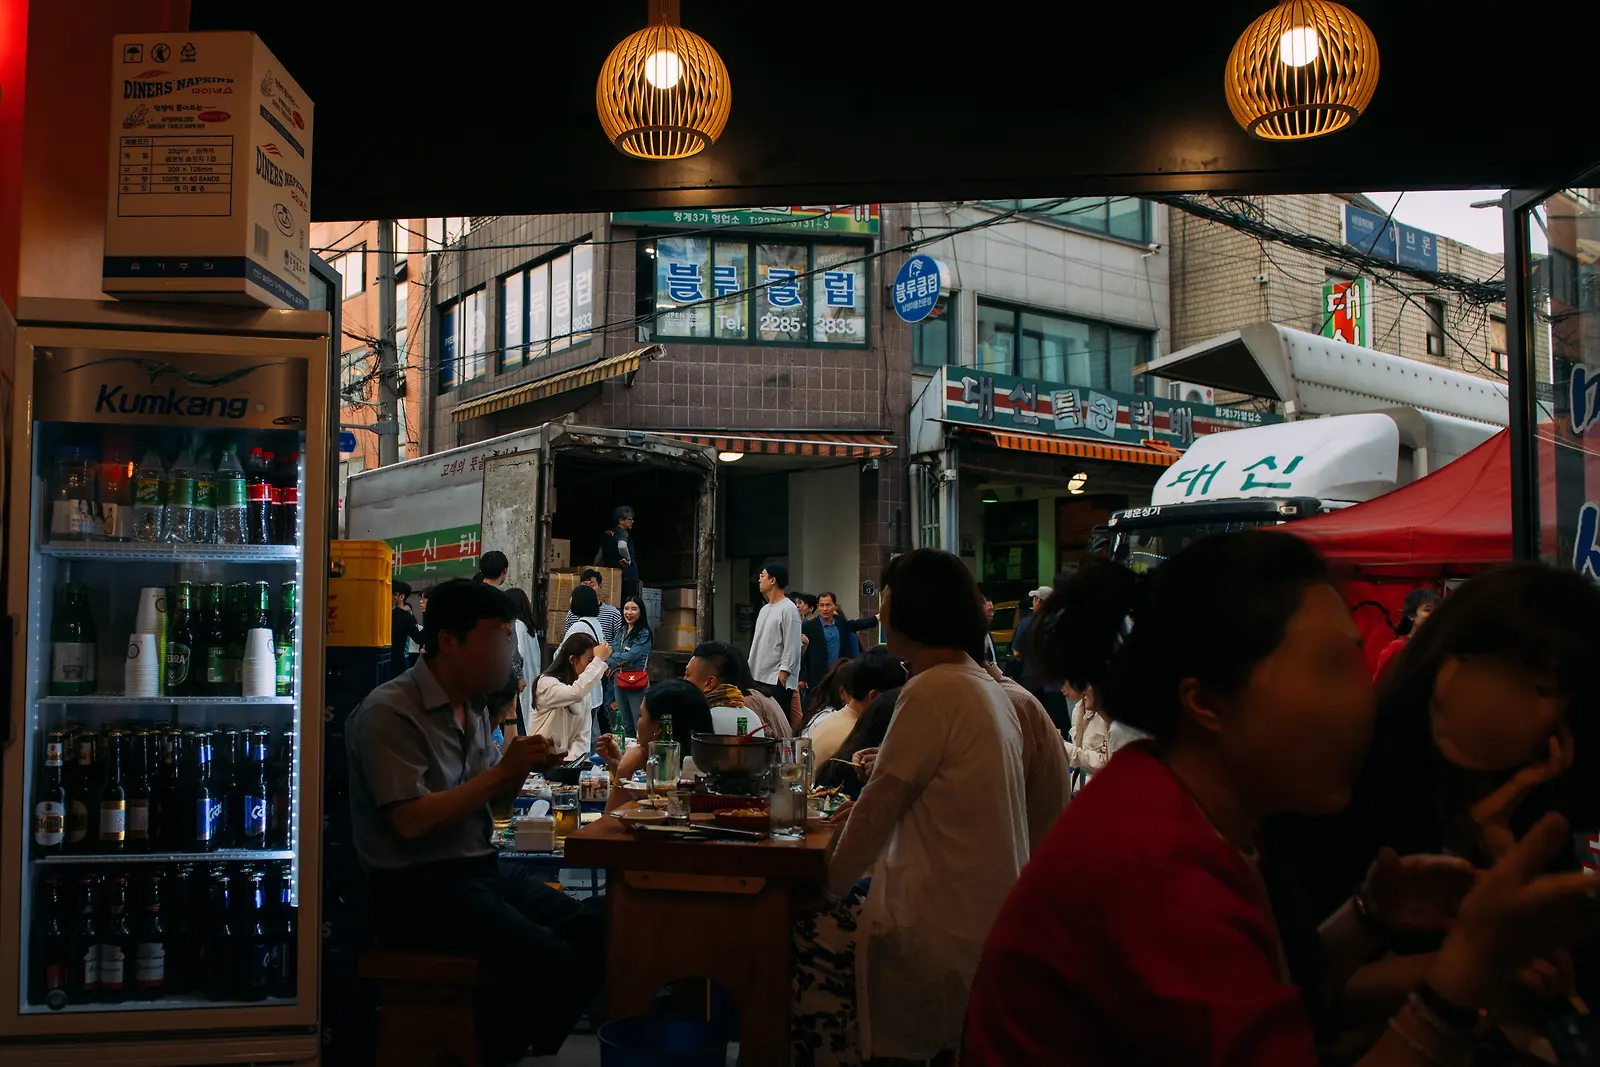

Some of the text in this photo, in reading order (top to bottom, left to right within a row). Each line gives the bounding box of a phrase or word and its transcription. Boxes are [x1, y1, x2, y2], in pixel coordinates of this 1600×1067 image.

[672, 211, 709, 223] 청계3가
[711, 213, 740, 225] 영업소
[895, 272, 938, 305] 블루클럽
[717, 314, 746, 332] Tel.
[814, 316, 857, 335] 3833
[95, 384, 249, 419] Kumkang
[440, 453, 486, 477] 고객의 뜻을
[1166, 455, 1304, 497] 대신
[1123, 506, 1161, 519] 세운상가
[166, 654, 186, 665] ERRA
